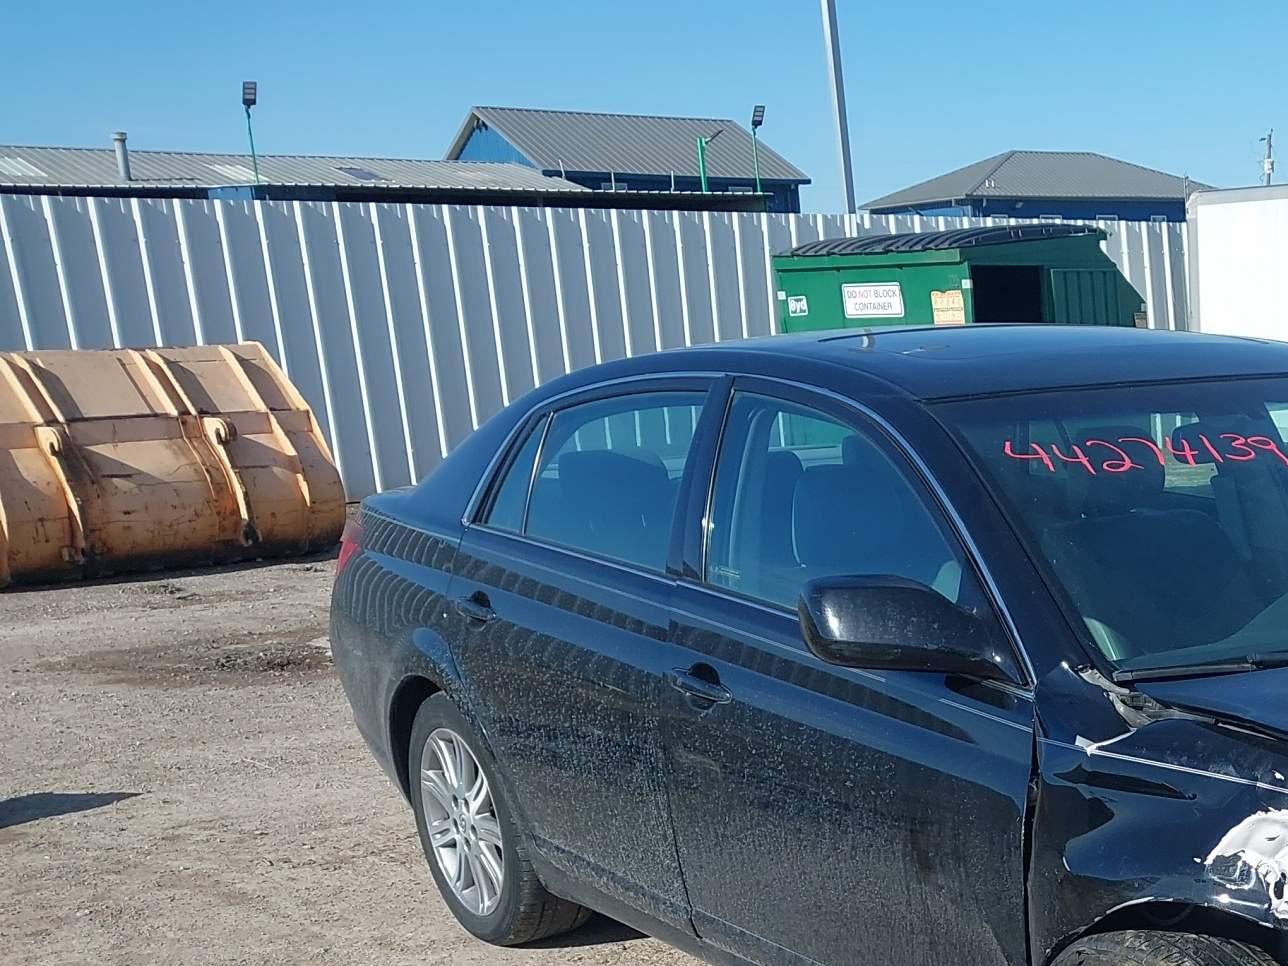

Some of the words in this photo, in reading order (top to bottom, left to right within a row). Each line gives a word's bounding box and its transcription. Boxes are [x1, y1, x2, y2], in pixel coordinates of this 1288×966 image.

[847, 290, 858, 299] DO
[858, 290, 873, 299] NOT
[873, 289, 898, 298] BLOCK
[853, 301, 893, 312] CONTAINER
